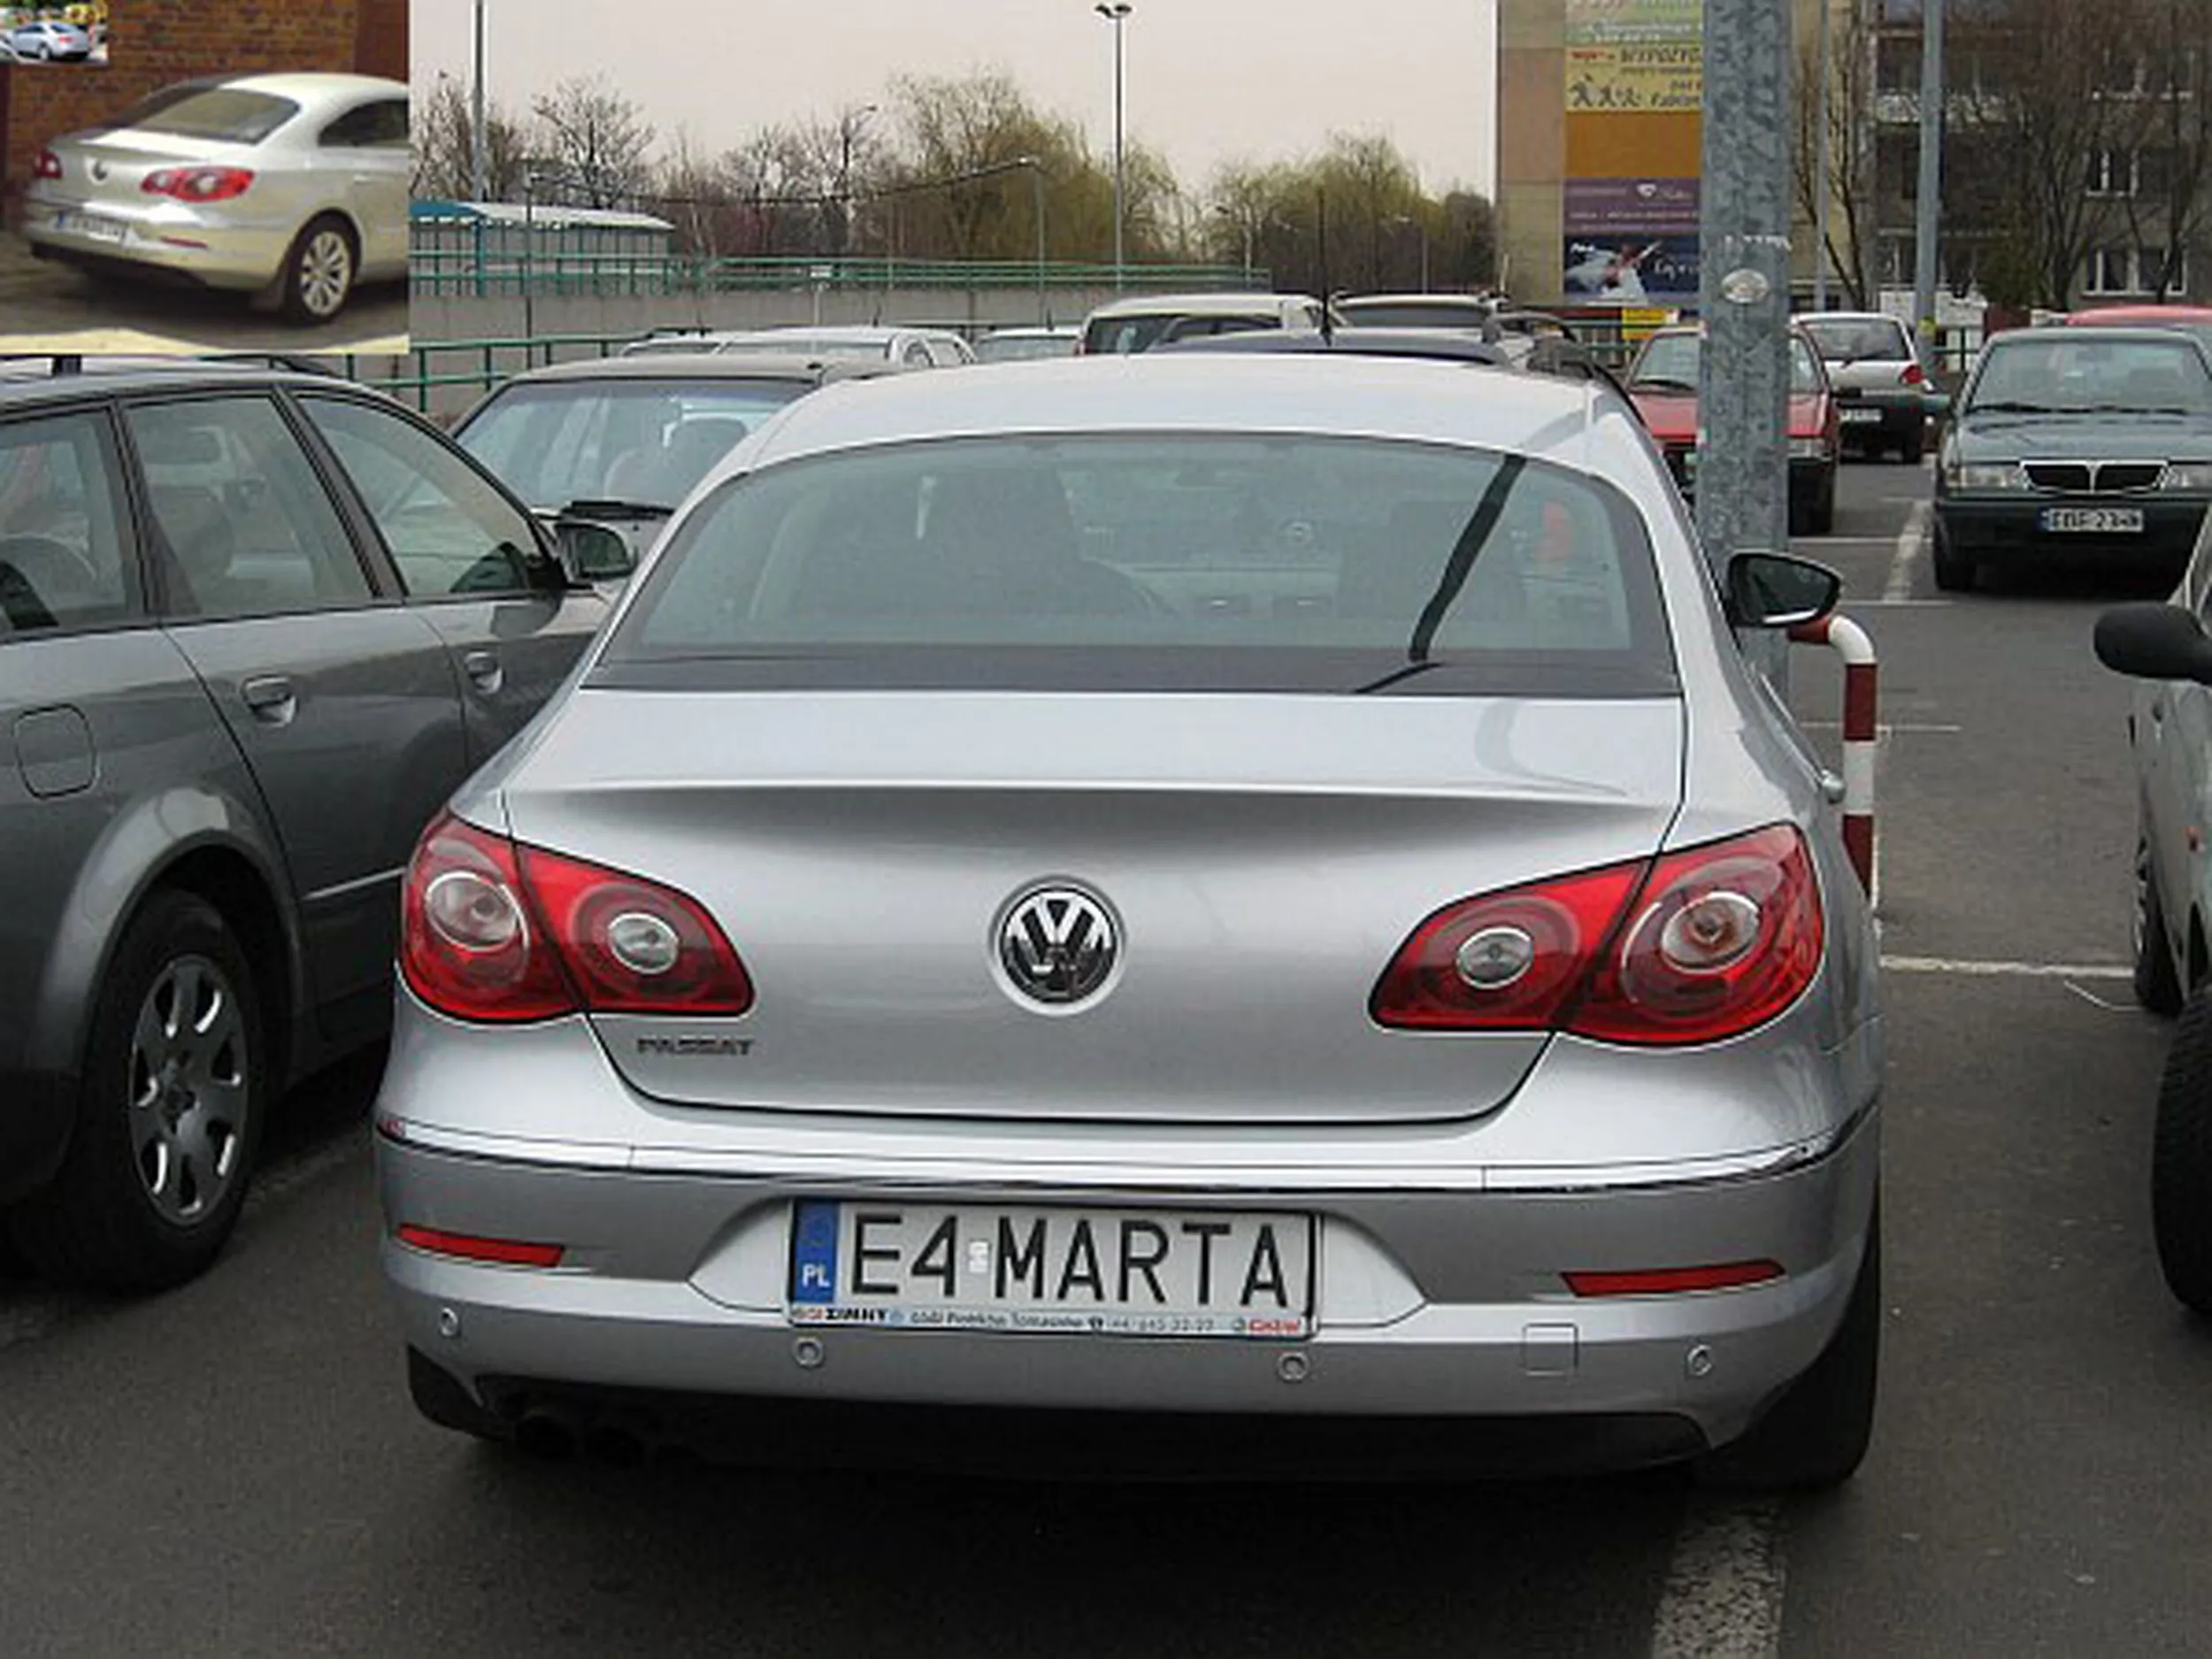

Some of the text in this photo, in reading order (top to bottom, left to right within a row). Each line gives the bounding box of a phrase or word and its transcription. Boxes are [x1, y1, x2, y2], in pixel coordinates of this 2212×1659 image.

[637, 1035, 756, 1056] PASSAT
[852, 1213, 1289, 1309] E4 MARTA
[801, 1263, 831, 1288] PL
